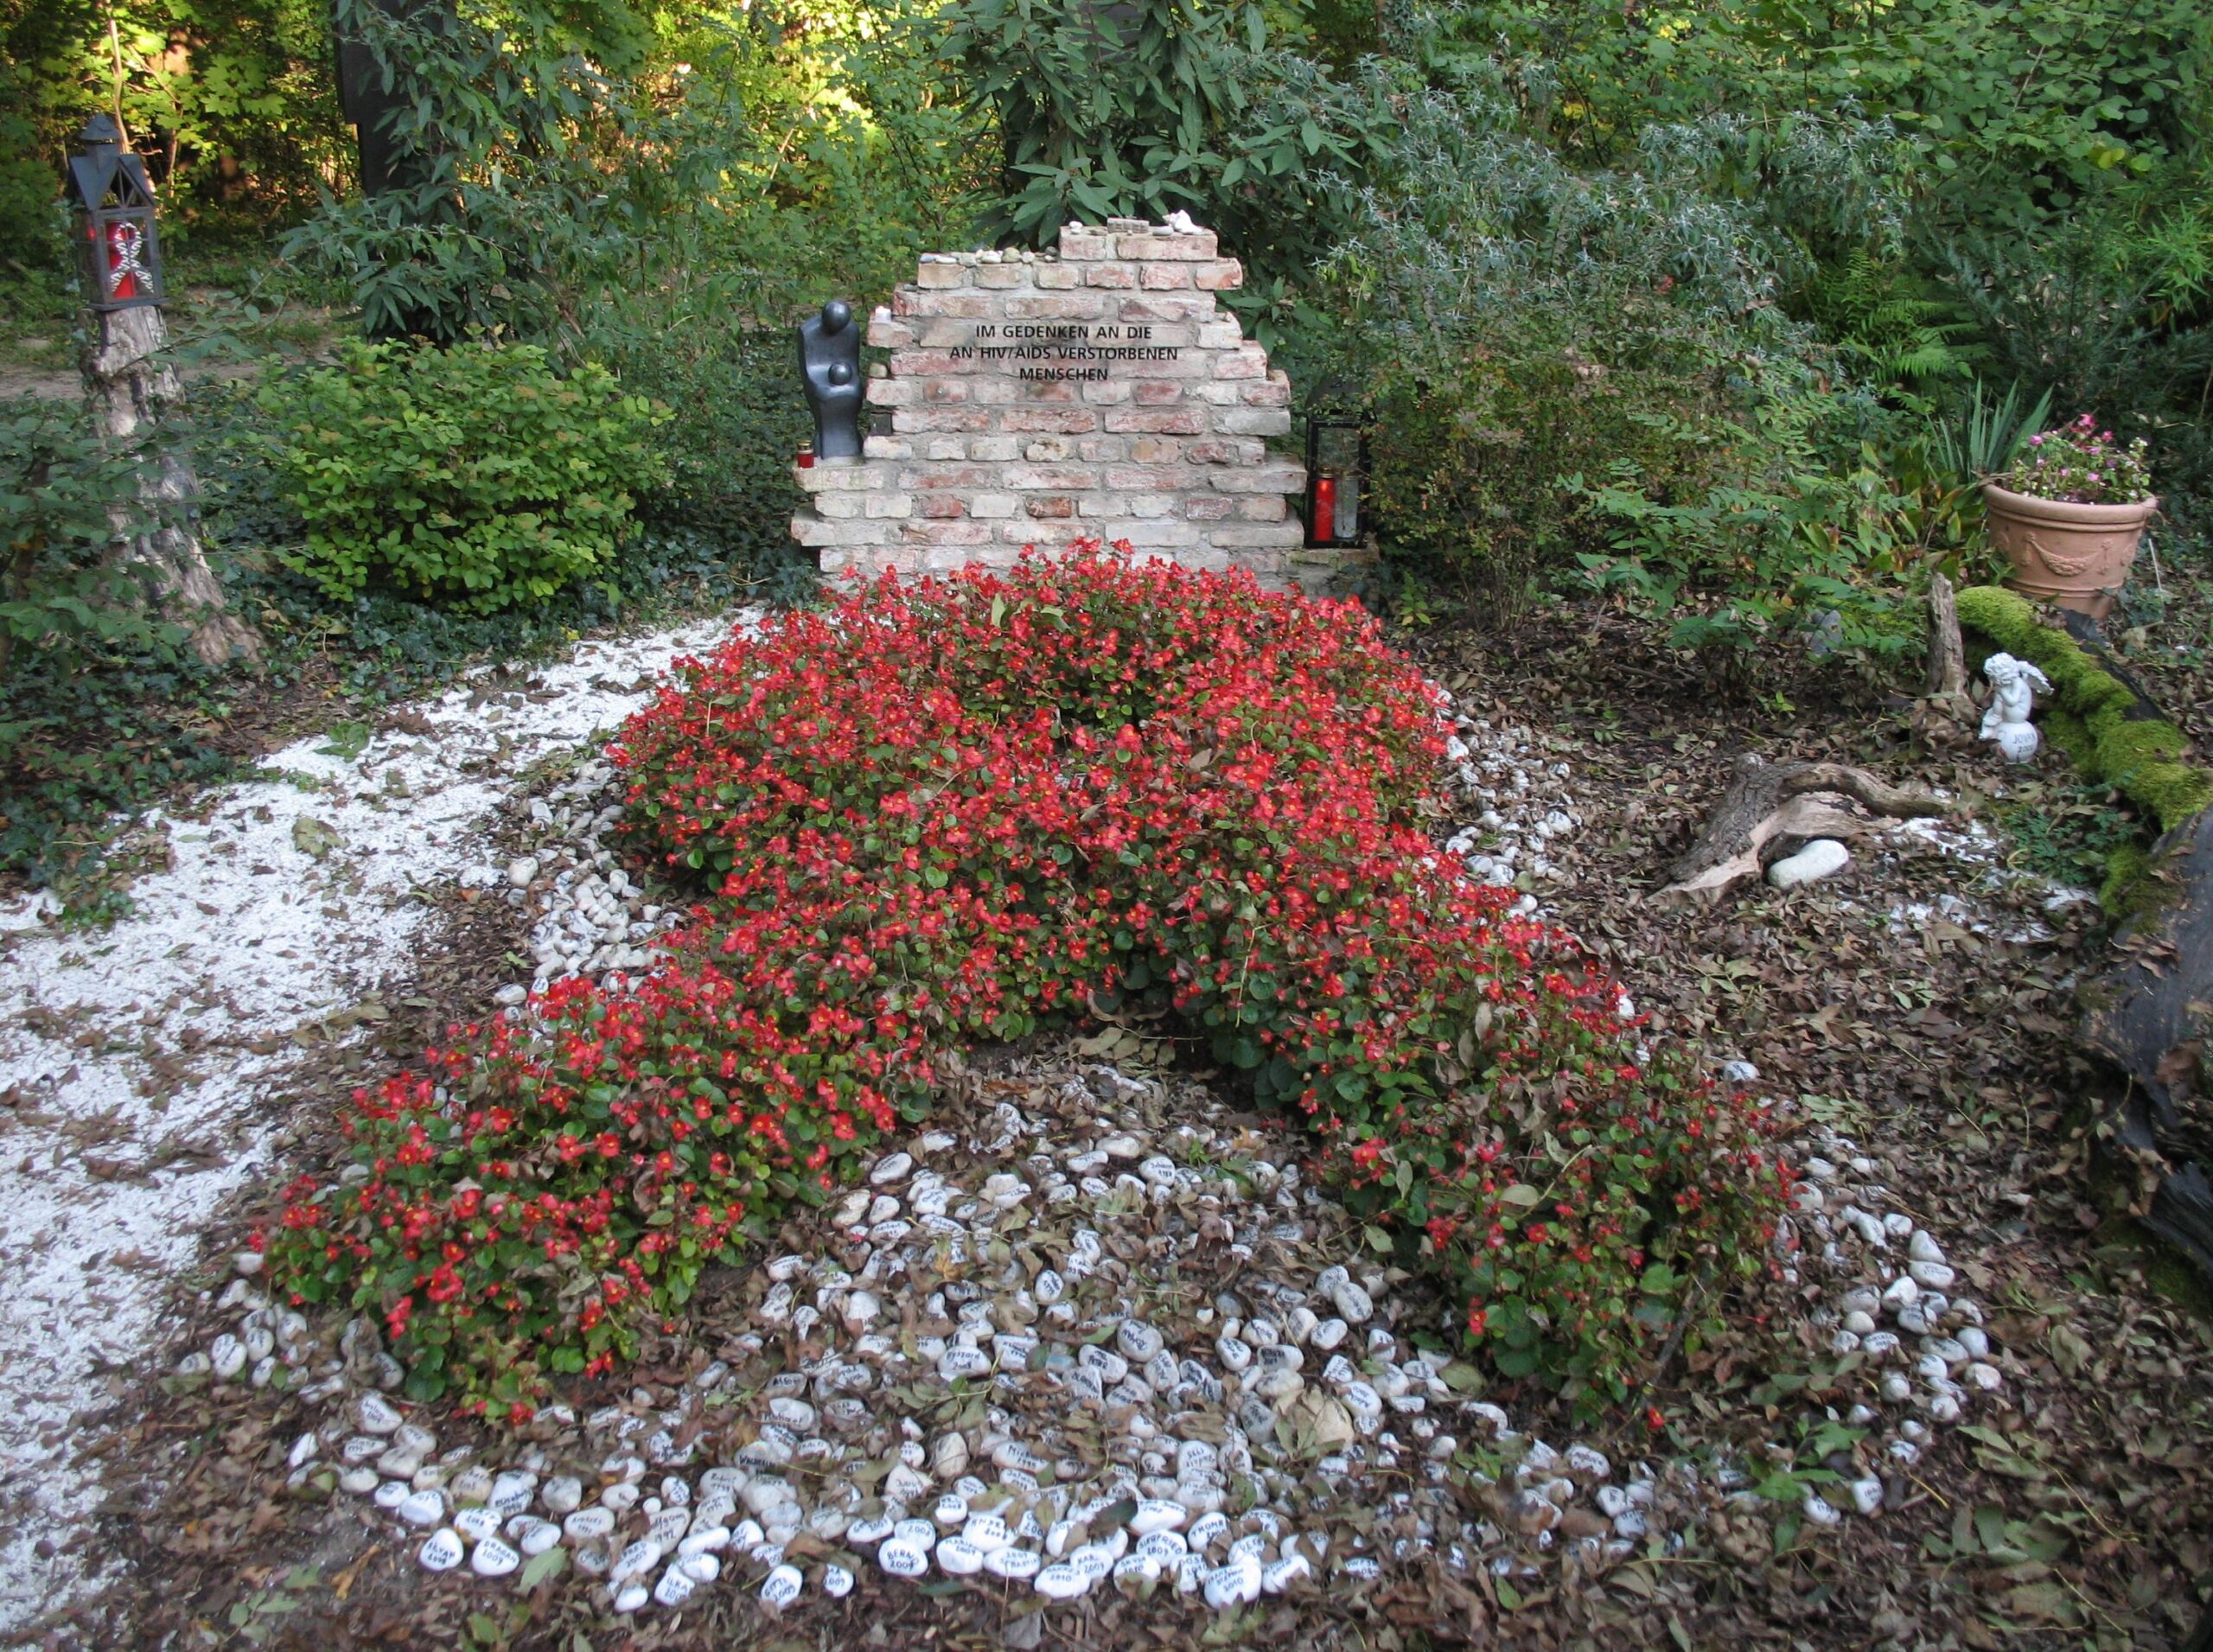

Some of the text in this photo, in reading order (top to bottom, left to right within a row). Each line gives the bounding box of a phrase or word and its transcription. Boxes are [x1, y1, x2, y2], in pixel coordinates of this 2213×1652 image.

[975, 324, 1152, 340] IM GEDENKEN AN DIE
[949, 347, 1178, 360] AN HIV/AIDS VERSTORBENEN
[1019, 367, 1108, 380] MENSCHEN
